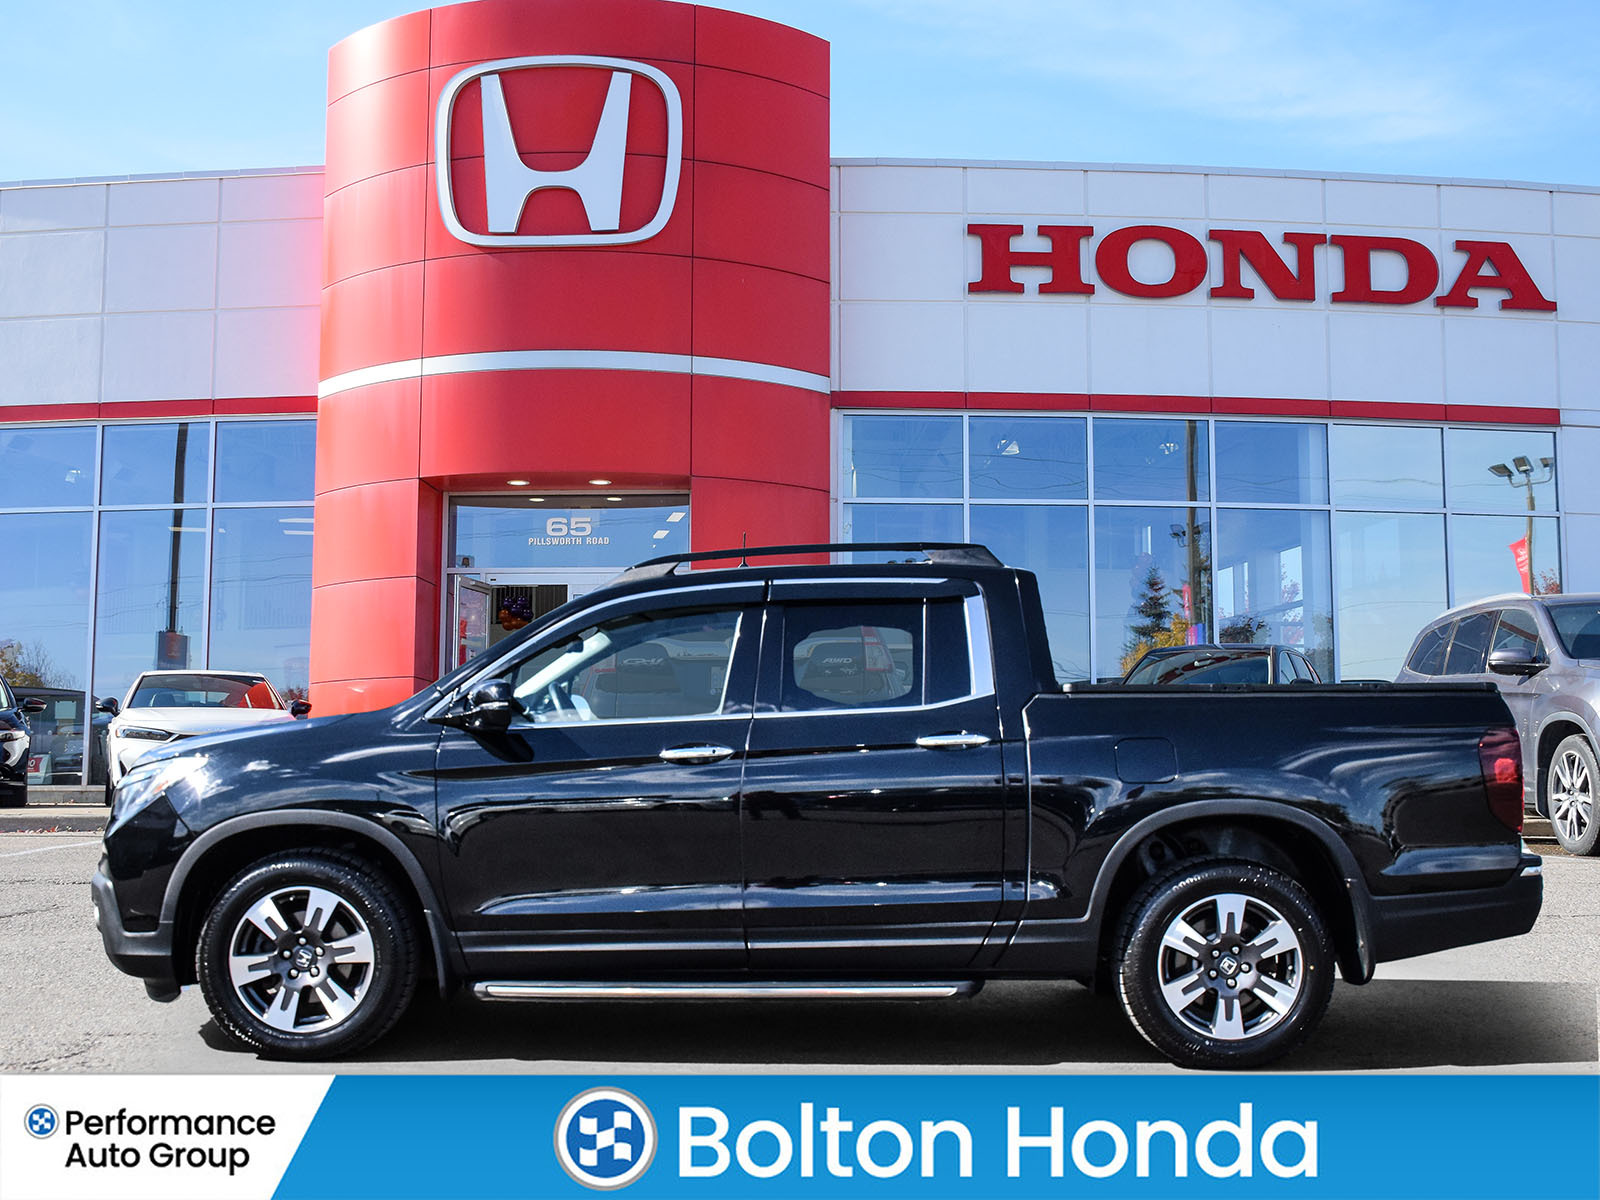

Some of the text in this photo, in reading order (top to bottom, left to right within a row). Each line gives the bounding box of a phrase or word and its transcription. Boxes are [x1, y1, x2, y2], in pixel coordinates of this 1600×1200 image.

[966, 223, 1558, 312] HONDA
[546, 517, 592, 536] 65
[528, 536, 610, 546] PILLSWORTH ROAD
